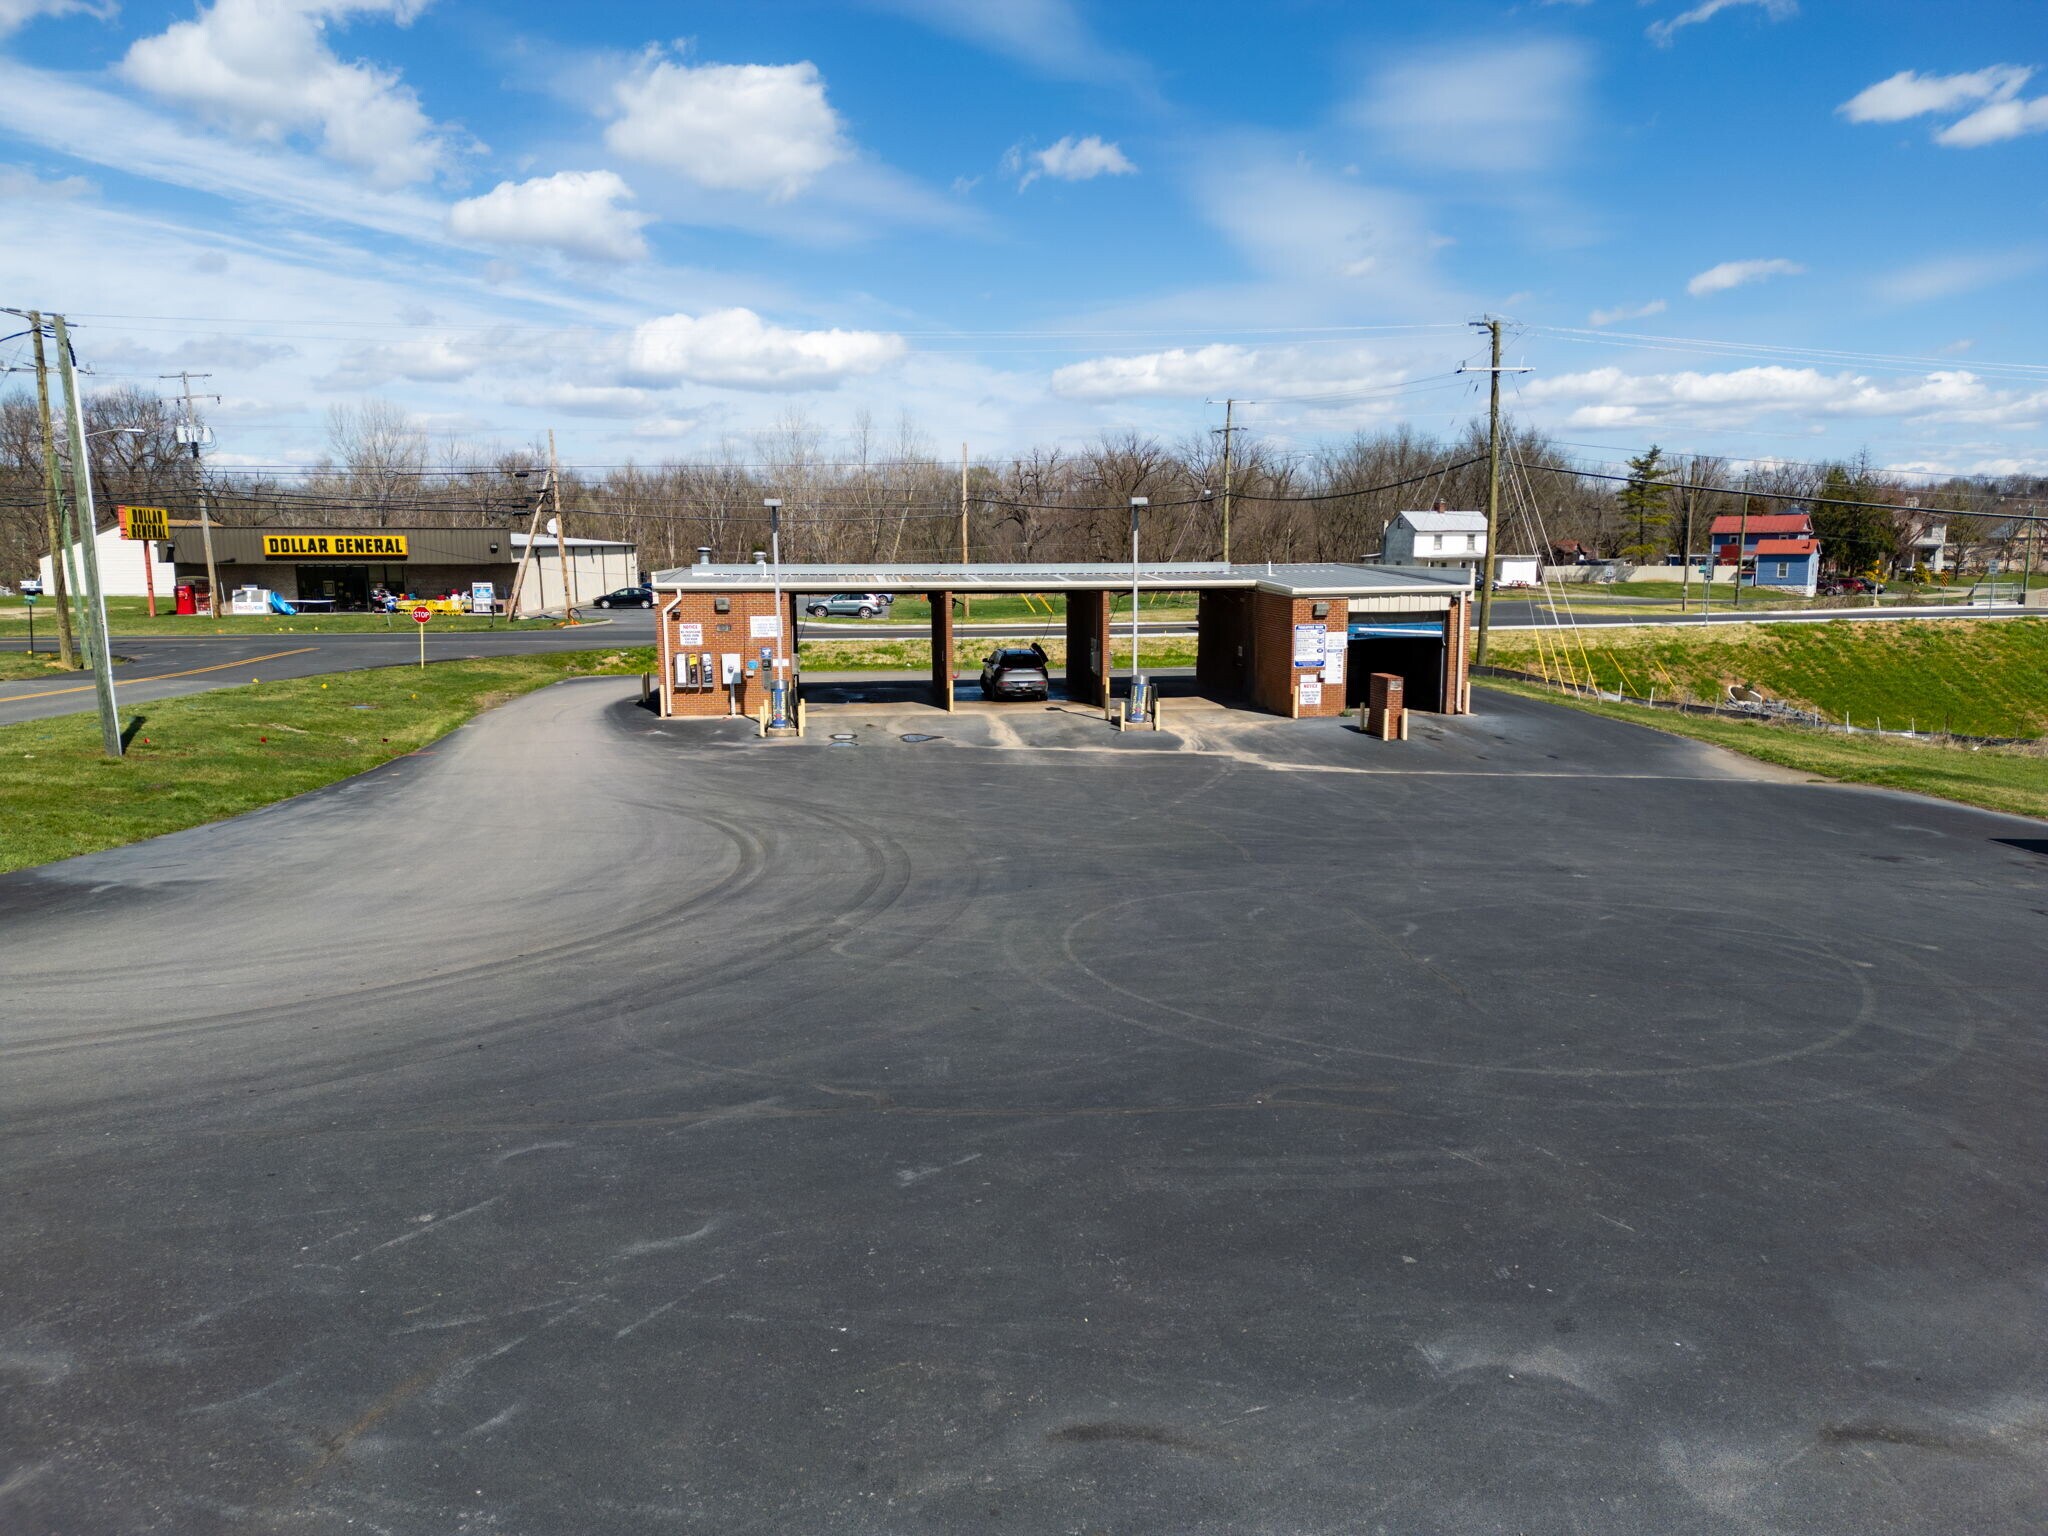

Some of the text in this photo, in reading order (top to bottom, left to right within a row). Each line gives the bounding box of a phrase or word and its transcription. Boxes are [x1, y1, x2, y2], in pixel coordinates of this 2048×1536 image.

[132, 509, 163, 525] DOLLAR
[132, 524, 167, 539] GENERAL
[268, 537, 403, 553] DOLLAR GENERAL
[413, 611, 430, 619] STOP
